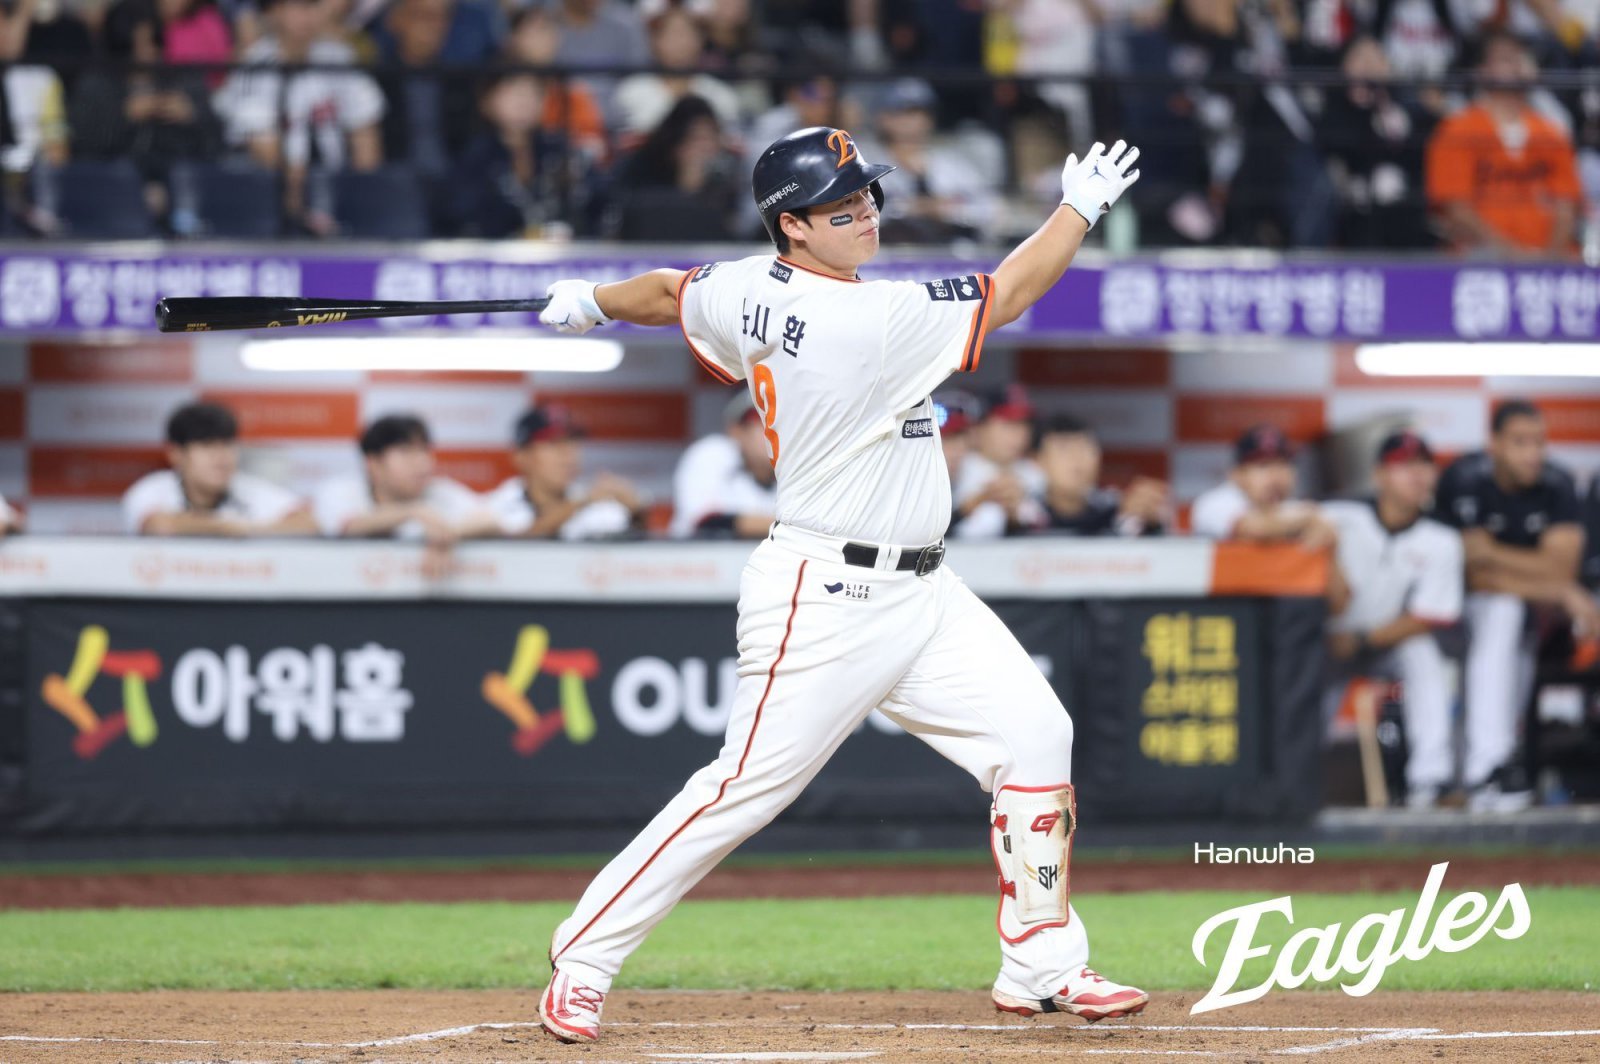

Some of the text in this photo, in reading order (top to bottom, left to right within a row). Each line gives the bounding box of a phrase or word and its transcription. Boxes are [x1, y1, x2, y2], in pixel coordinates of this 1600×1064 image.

[846, 583, 870, 593] LIFE
[845, 590, 869, 600] PLUS
[171, 643, 413, 742] 아워홈
